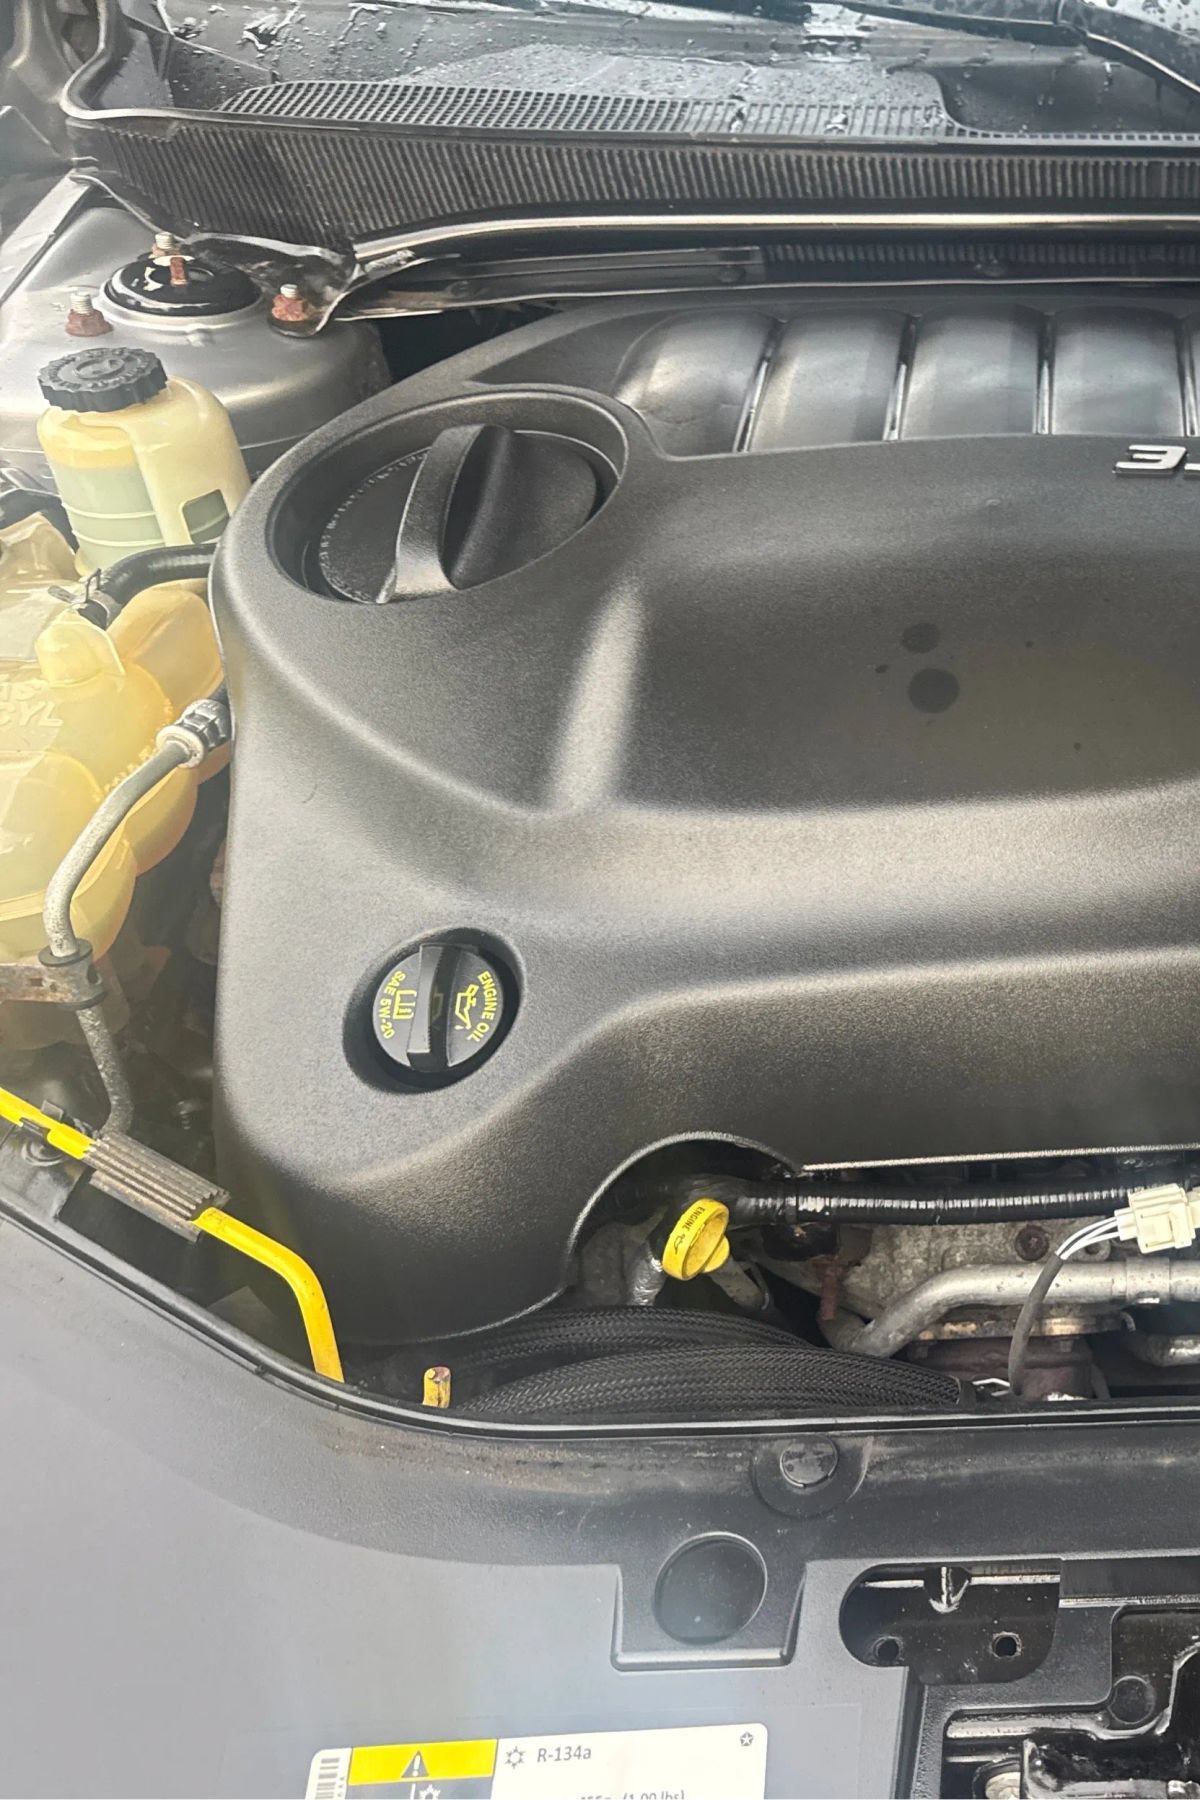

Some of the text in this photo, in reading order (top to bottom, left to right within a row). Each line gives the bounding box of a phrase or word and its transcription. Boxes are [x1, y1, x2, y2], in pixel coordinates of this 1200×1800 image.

[378, 970, 407, 1040] SAE 5W-20
[466, 970, 498, 1042] ENGINE OIL
[682, 1206, 706, 1231] ENGINE
[537, 1745, 592, 1763] R-134a
